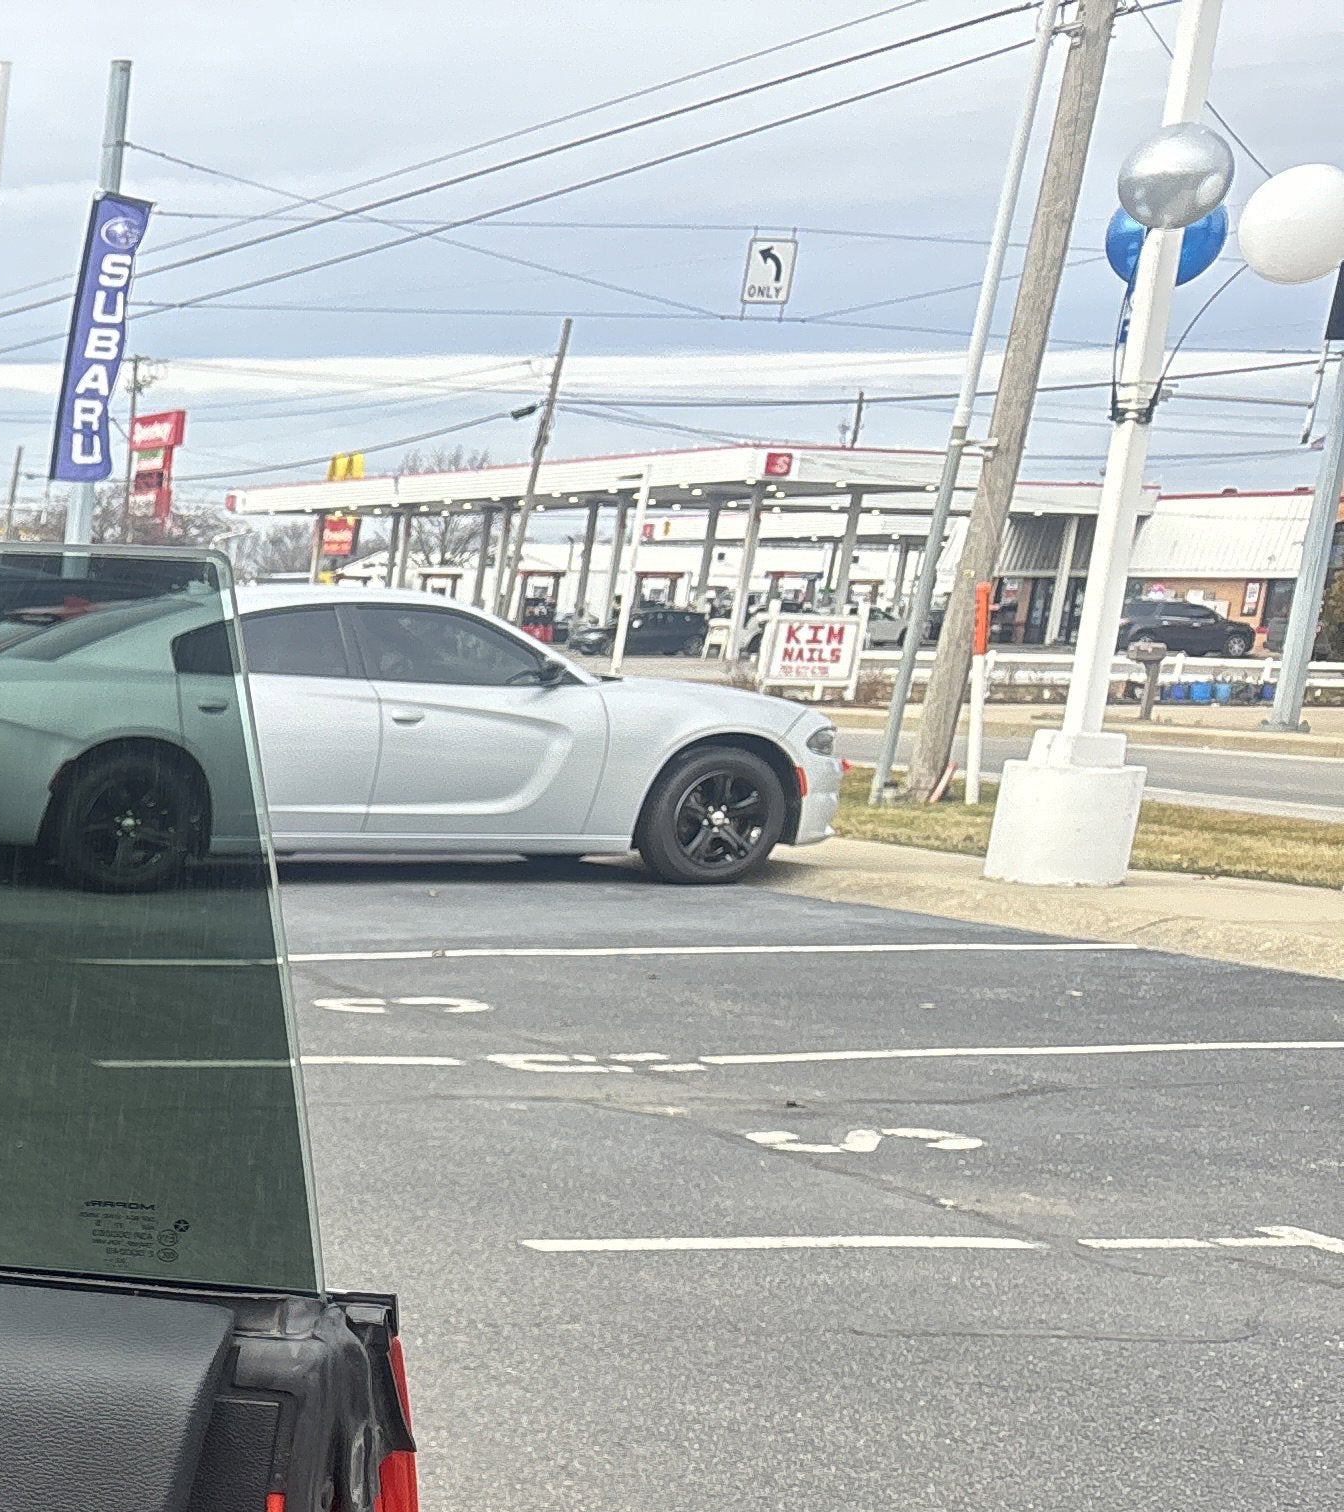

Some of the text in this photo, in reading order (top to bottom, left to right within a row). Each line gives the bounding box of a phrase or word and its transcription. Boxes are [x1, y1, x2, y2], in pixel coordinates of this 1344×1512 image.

[747, 284, 783, 299] ONLY
[71, 253, 131, 464] SUBARU
[785, 625, 846, 645] KIM
[782, 647, 842, 664] NAILS
